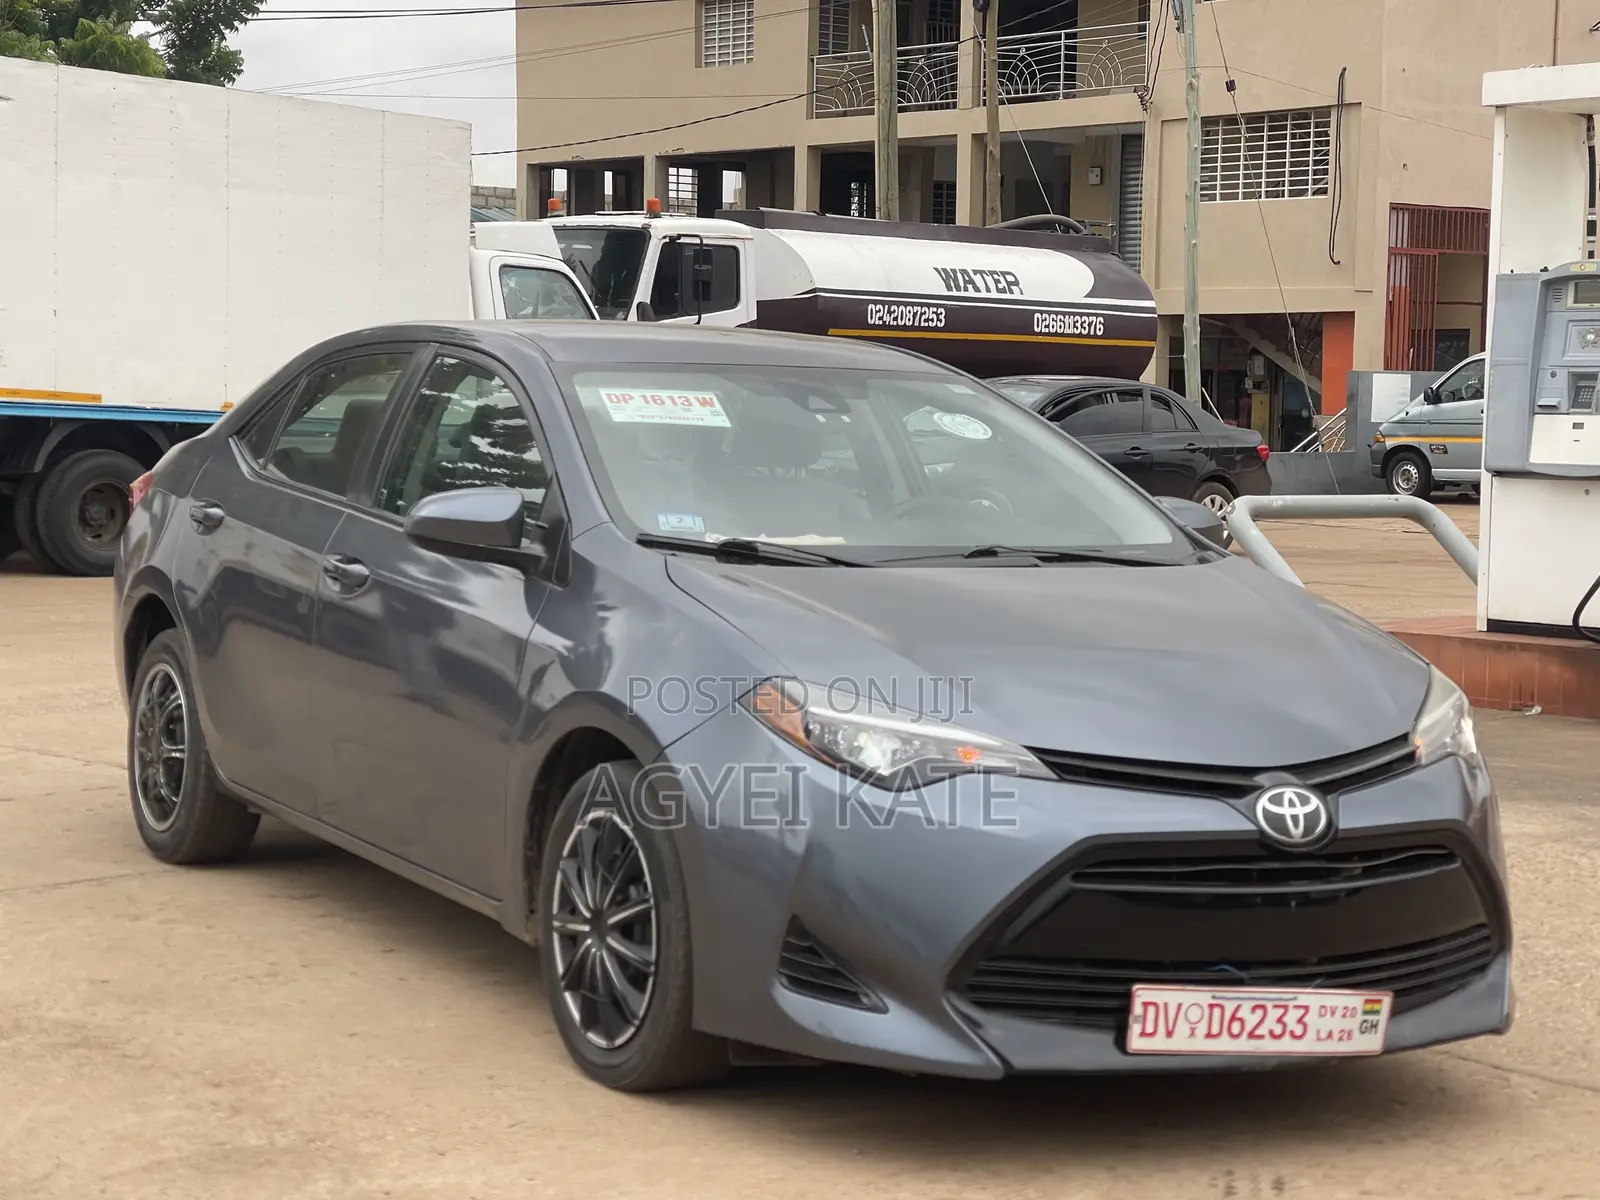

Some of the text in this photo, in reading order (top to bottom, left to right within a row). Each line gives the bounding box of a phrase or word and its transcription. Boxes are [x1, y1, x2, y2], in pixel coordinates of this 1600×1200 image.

[933, 266, 1024, 295] WATER
[867, 303, 946, 328] 0242087253
[1034, 312, 1105, 336] 0266113376
[604, 392, 635, 405] DP
[639, 393, 694, 408] 1613
[1138, 1001, 1310, 1041] DV D6233
[1318, 1004, 1358, 1019] DV 20
[1316, 1029, 1334, 1042] LA
[1359, 1019, 1380, 1036] GH
